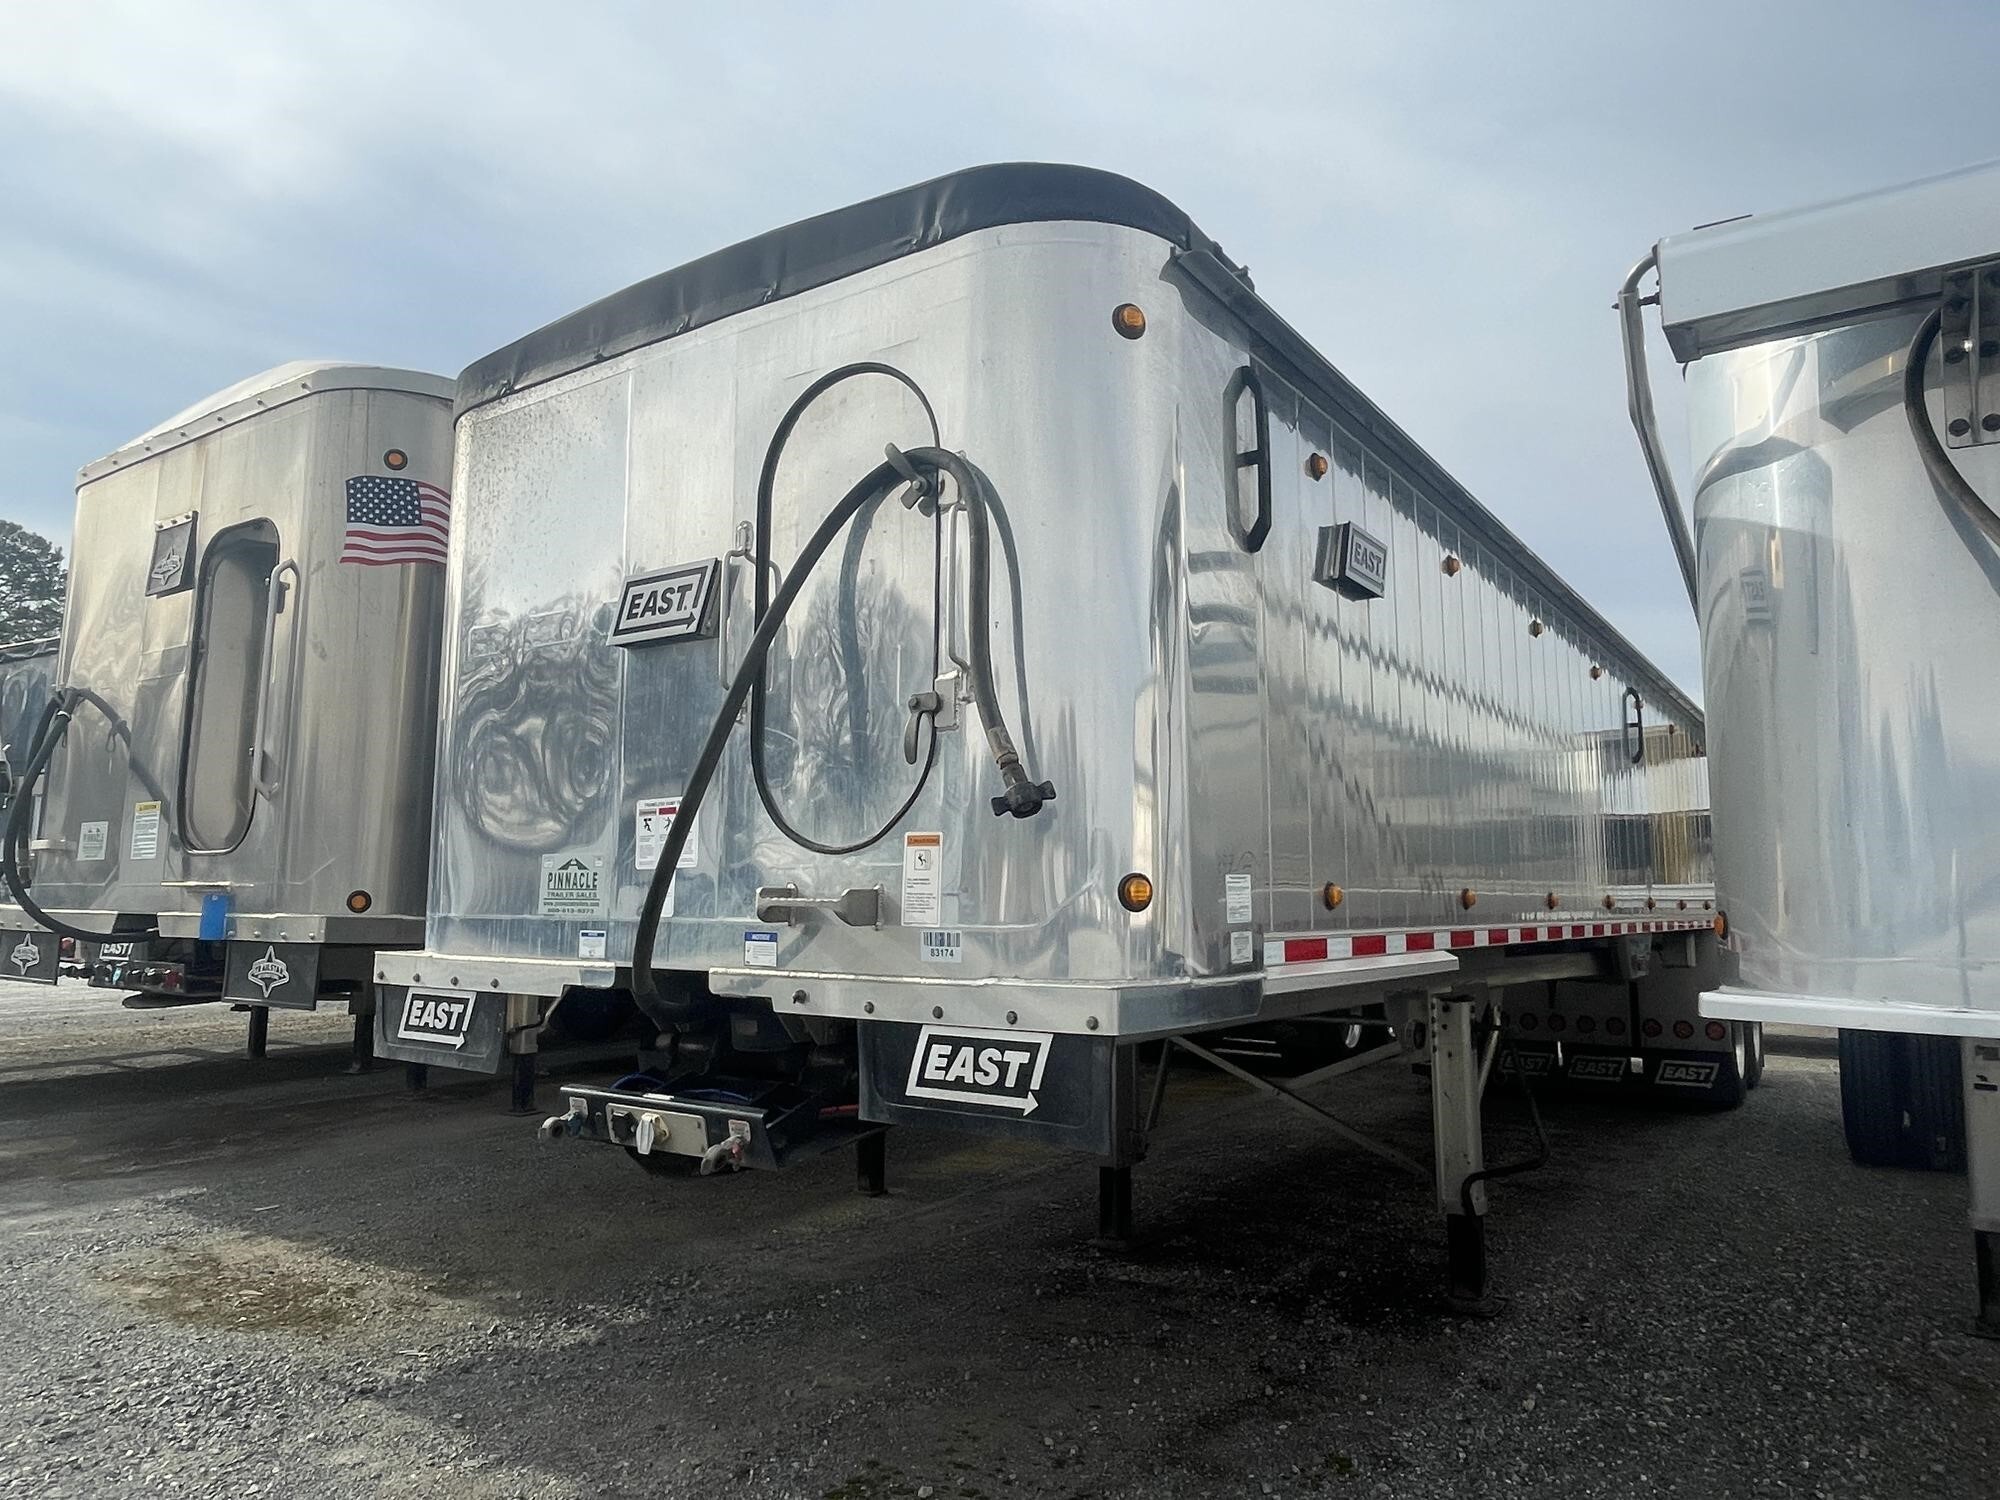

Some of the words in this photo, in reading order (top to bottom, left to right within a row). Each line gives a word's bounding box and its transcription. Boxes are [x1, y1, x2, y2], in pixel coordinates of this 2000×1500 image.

[1354, 541, 1382, 578] EAST
[625, 583, 694, 620] EAST
[547, 872, 598, 889] PINNACLE
[930, 948, 954, 957] 83174
[408, 1000, 464, 1030] EAST
[924, 1044, 1031, 1088] EAST
[1575, 1062, 1619, 1076] EAST
[1663, 1066, 1711, 1081] EAST
